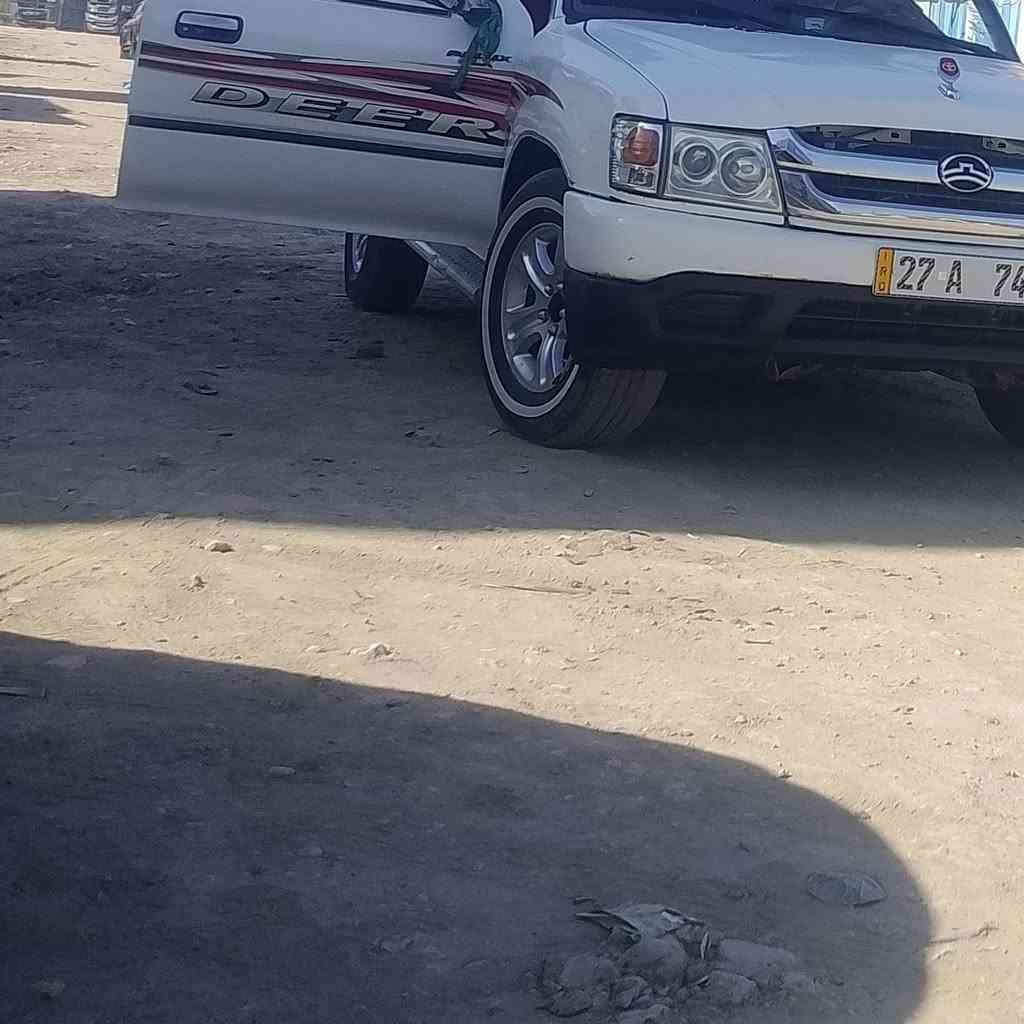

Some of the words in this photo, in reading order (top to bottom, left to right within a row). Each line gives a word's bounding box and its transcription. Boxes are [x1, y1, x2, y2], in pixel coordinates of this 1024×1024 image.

[190, 81, 506, 144] DEER
[897, 255, 936, 292] 27
[945, 259, 962, 294] A
